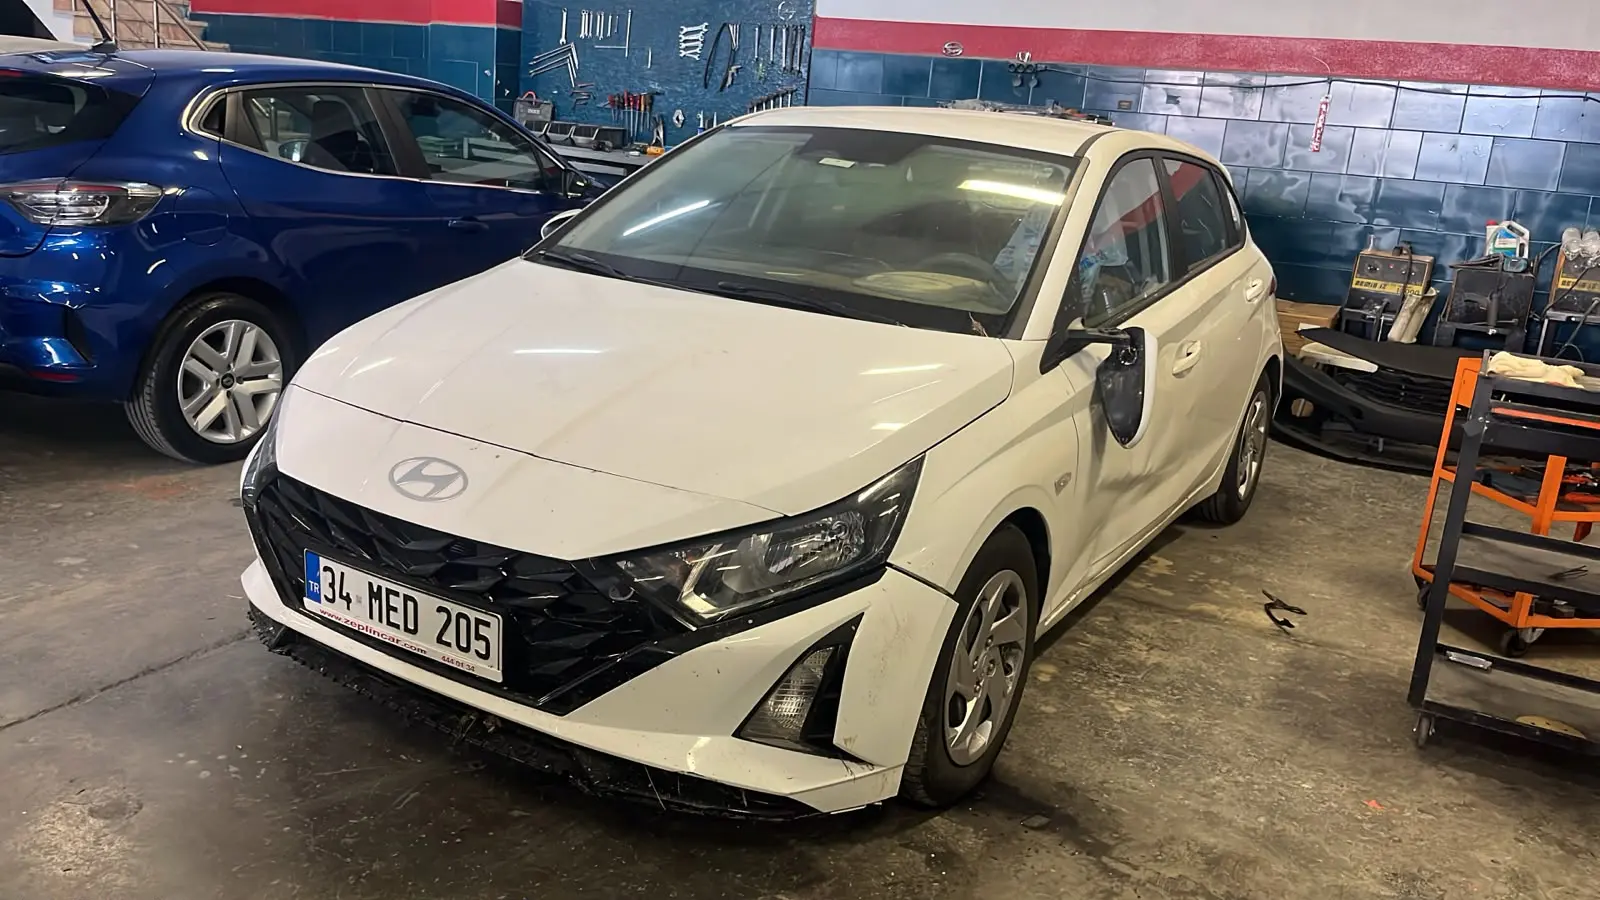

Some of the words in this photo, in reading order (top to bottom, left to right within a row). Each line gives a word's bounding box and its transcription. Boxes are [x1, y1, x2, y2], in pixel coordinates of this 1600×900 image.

[308, 580, 320, 594] TR
[322, 565, 352, 610] 34
[368, 581, 418, 635] MED
[436, 605, 491, 661] 205
[319, 608, 427, 655] www.zeplincar.com
[441, 655, 456, 665] 444
[466, 664, 475, 673] 34
